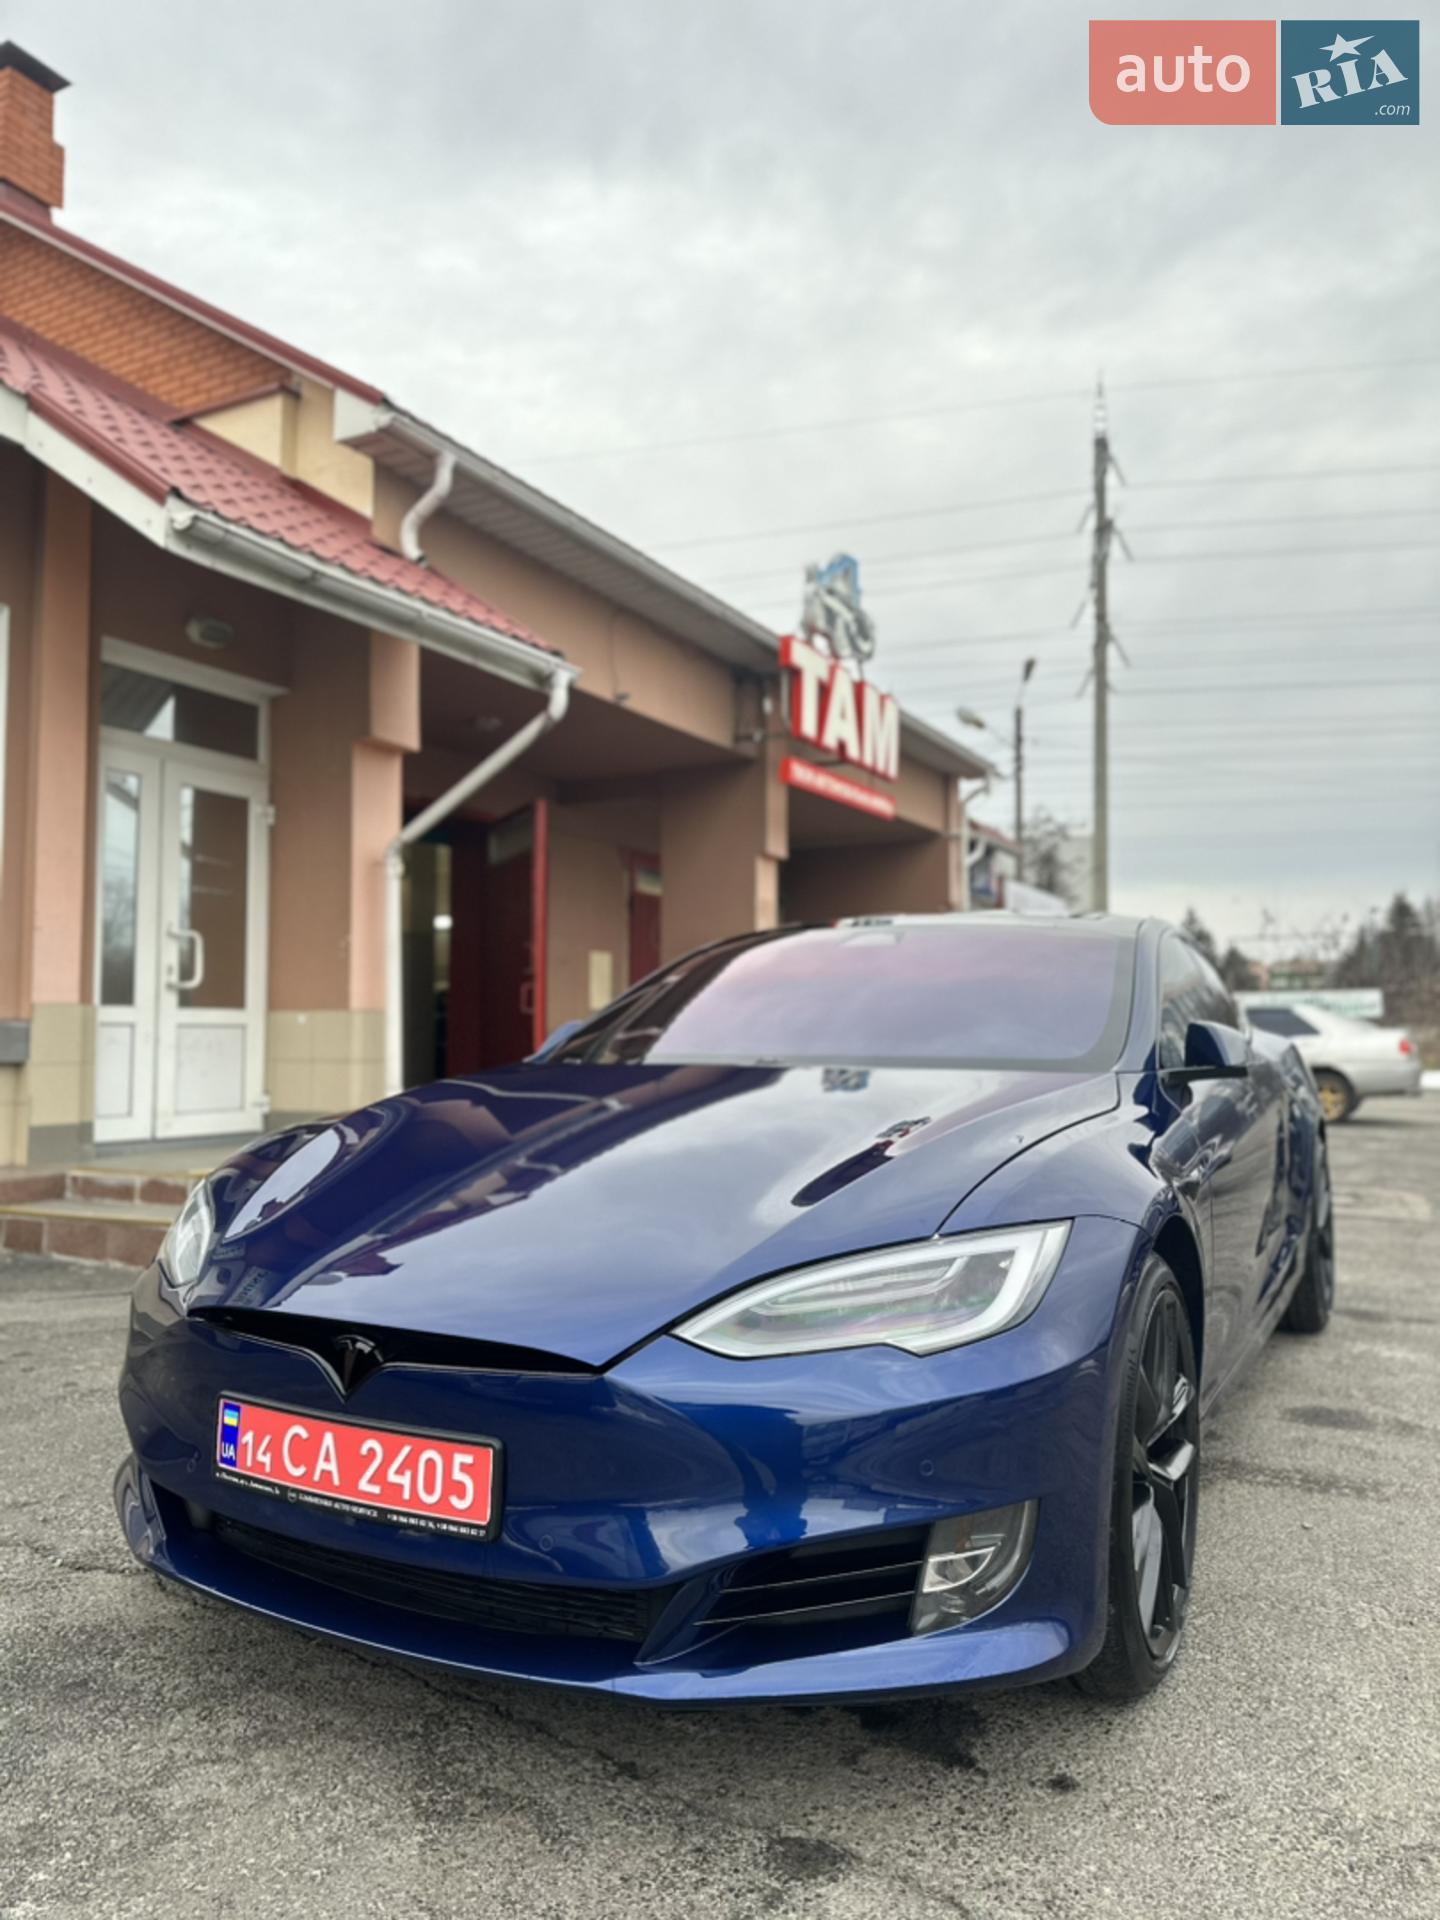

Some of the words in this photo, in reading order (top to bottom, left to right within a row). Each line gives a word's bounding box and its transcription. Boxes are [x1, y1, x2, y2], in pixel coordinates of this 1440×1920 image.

[221, 1442, 236, 1461] UA
[241, 1430, 272, 1473] 14
[282, 1425, 340, 1486] CA
[358, 1439, 474, 1511] 2405
